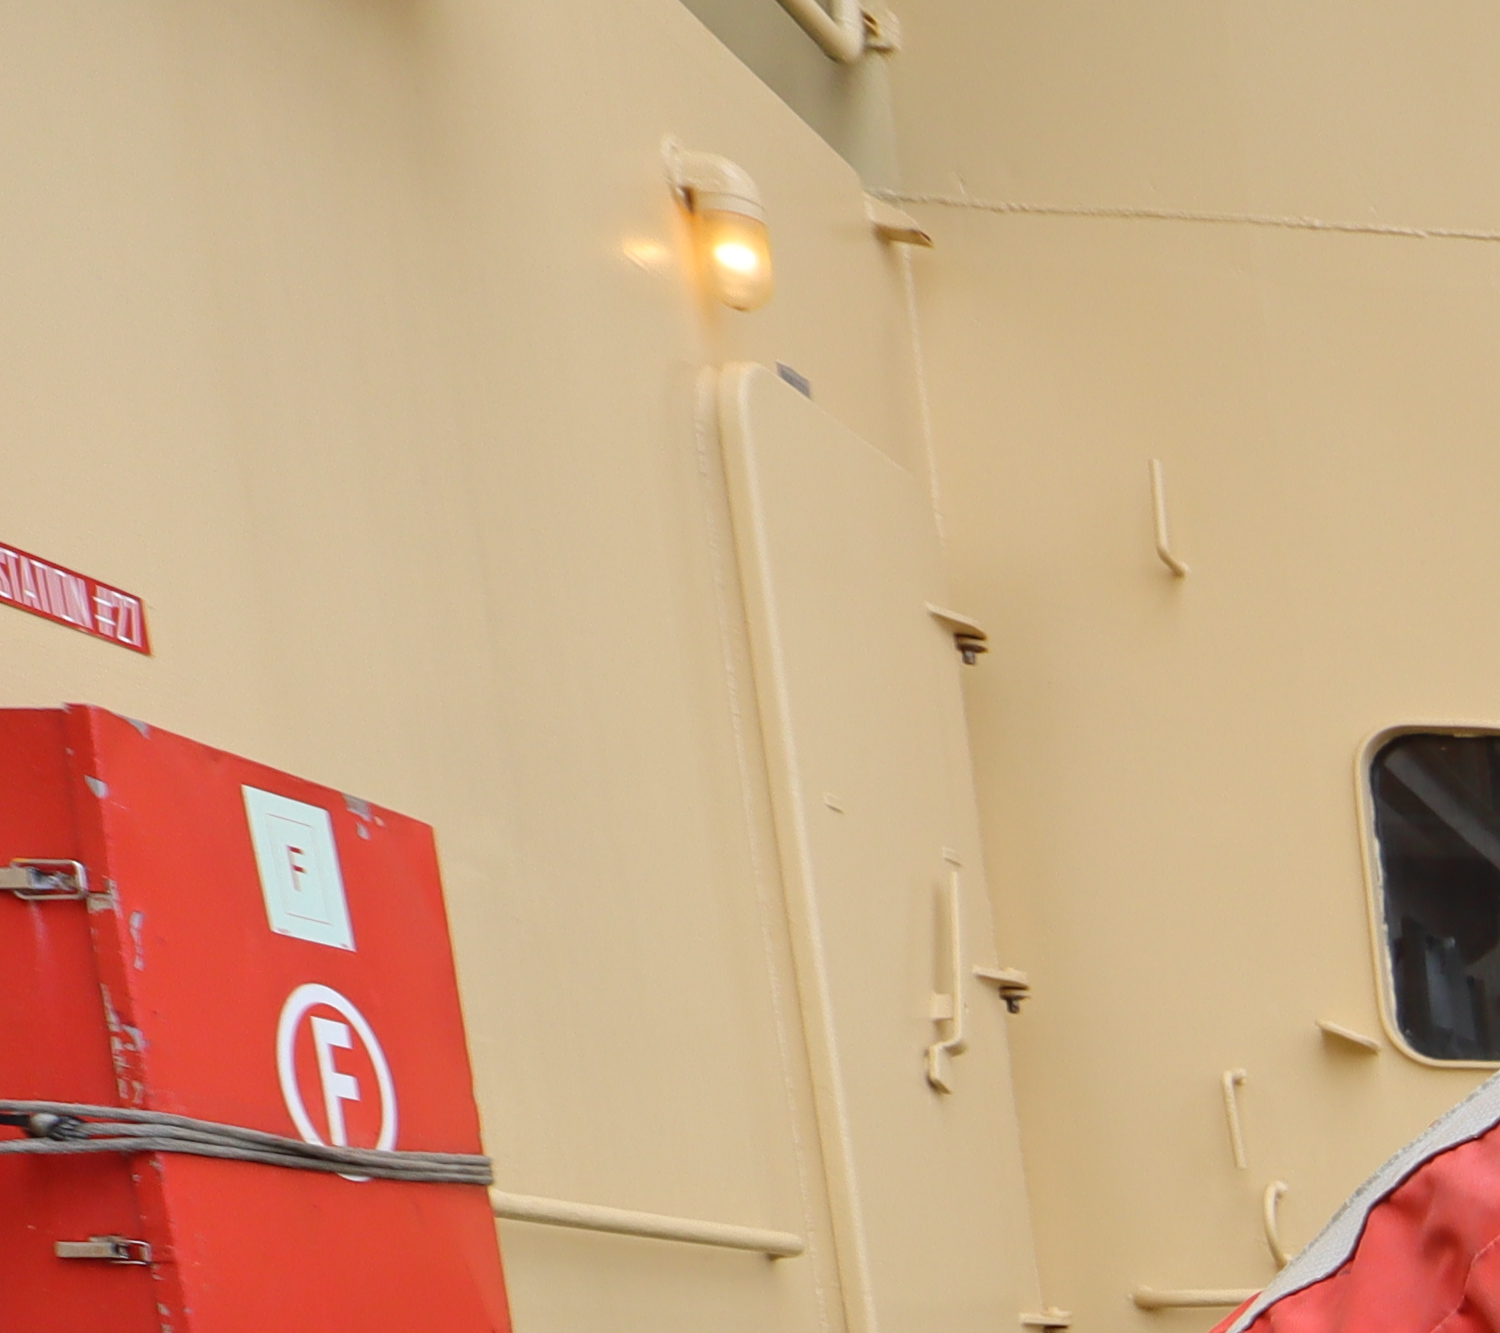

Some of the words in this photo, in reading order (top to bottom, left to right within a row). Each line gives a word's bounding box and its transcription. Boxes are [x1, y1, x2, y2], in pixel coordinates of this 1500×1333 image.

[92, 584, 143, 649] #27
[287, 844, 306, 892] F
[311, 1015, 360, 1147] F
